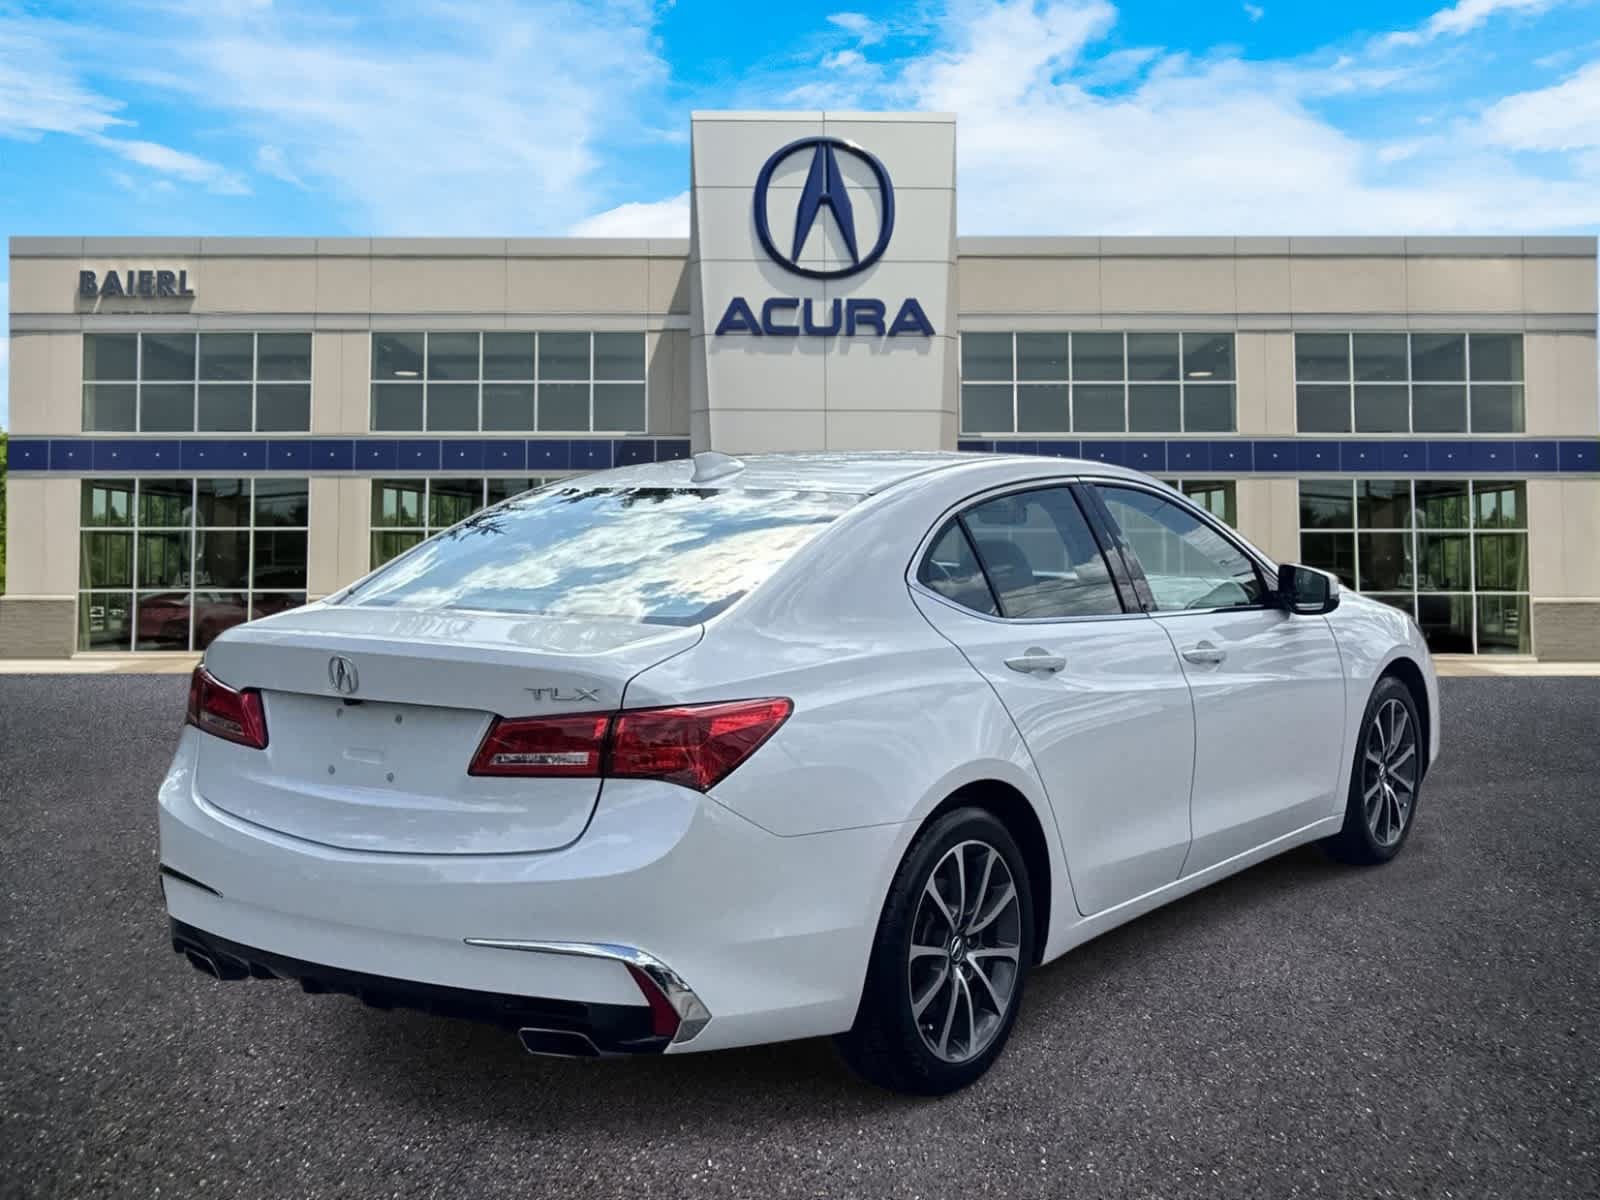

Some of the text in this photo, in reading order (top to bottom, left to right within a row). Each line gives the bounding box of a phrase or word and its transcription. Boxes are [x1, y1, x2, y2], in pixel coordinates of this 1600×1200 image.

[79, 269, 194, 297] BAIERL
[714, 297, 936, 337] ACURA
[523, 687, 601, 702] TLX
